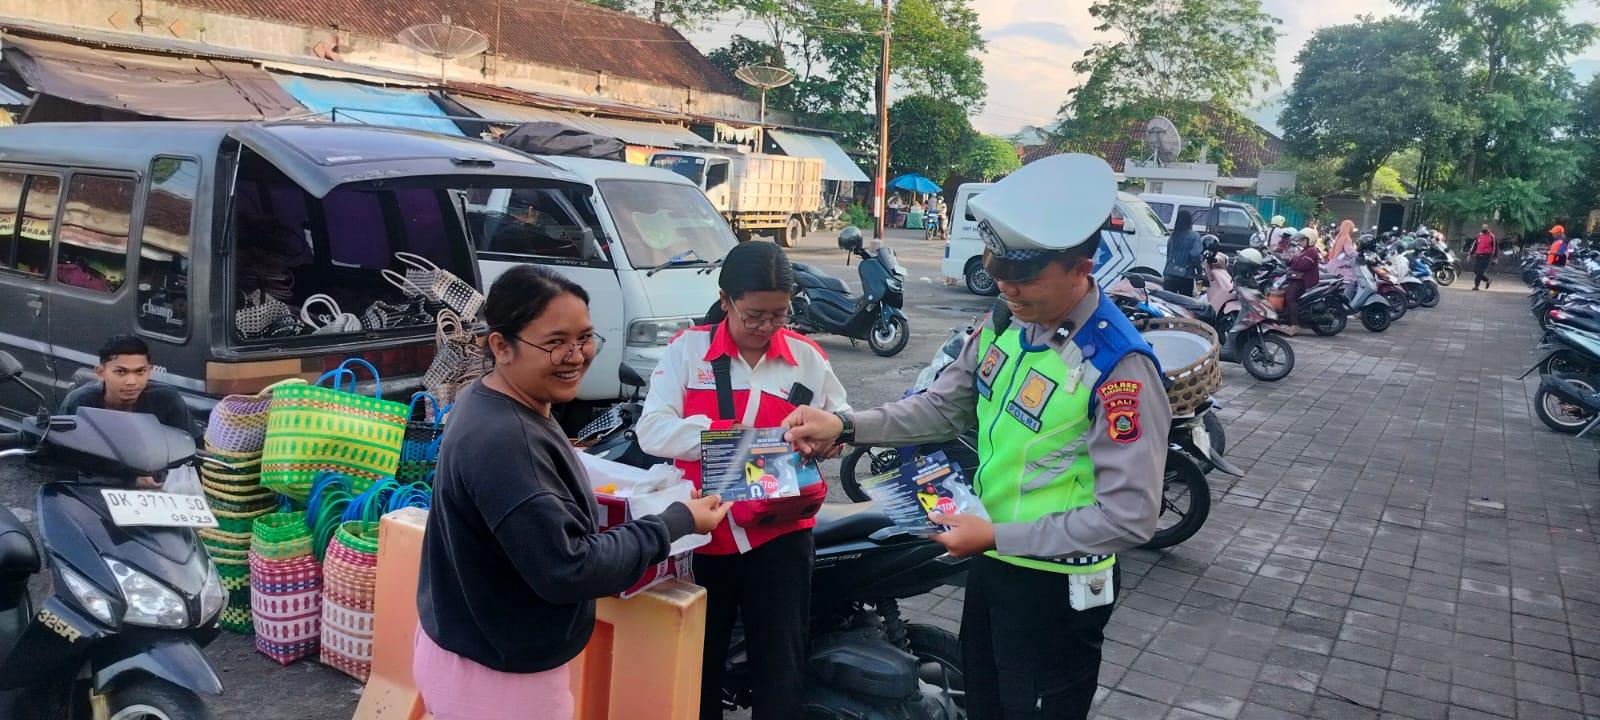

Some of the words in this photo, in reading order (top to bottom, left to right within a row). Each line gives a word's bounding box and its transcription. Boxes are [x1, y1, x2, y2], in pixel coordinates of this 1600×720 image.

[1110, 399, 1132, 407] BALI
[1008, 404, 1037, 429] POLRI
[106, 492, 132, 507] DK
[137, 494, 178, 510] 3711
